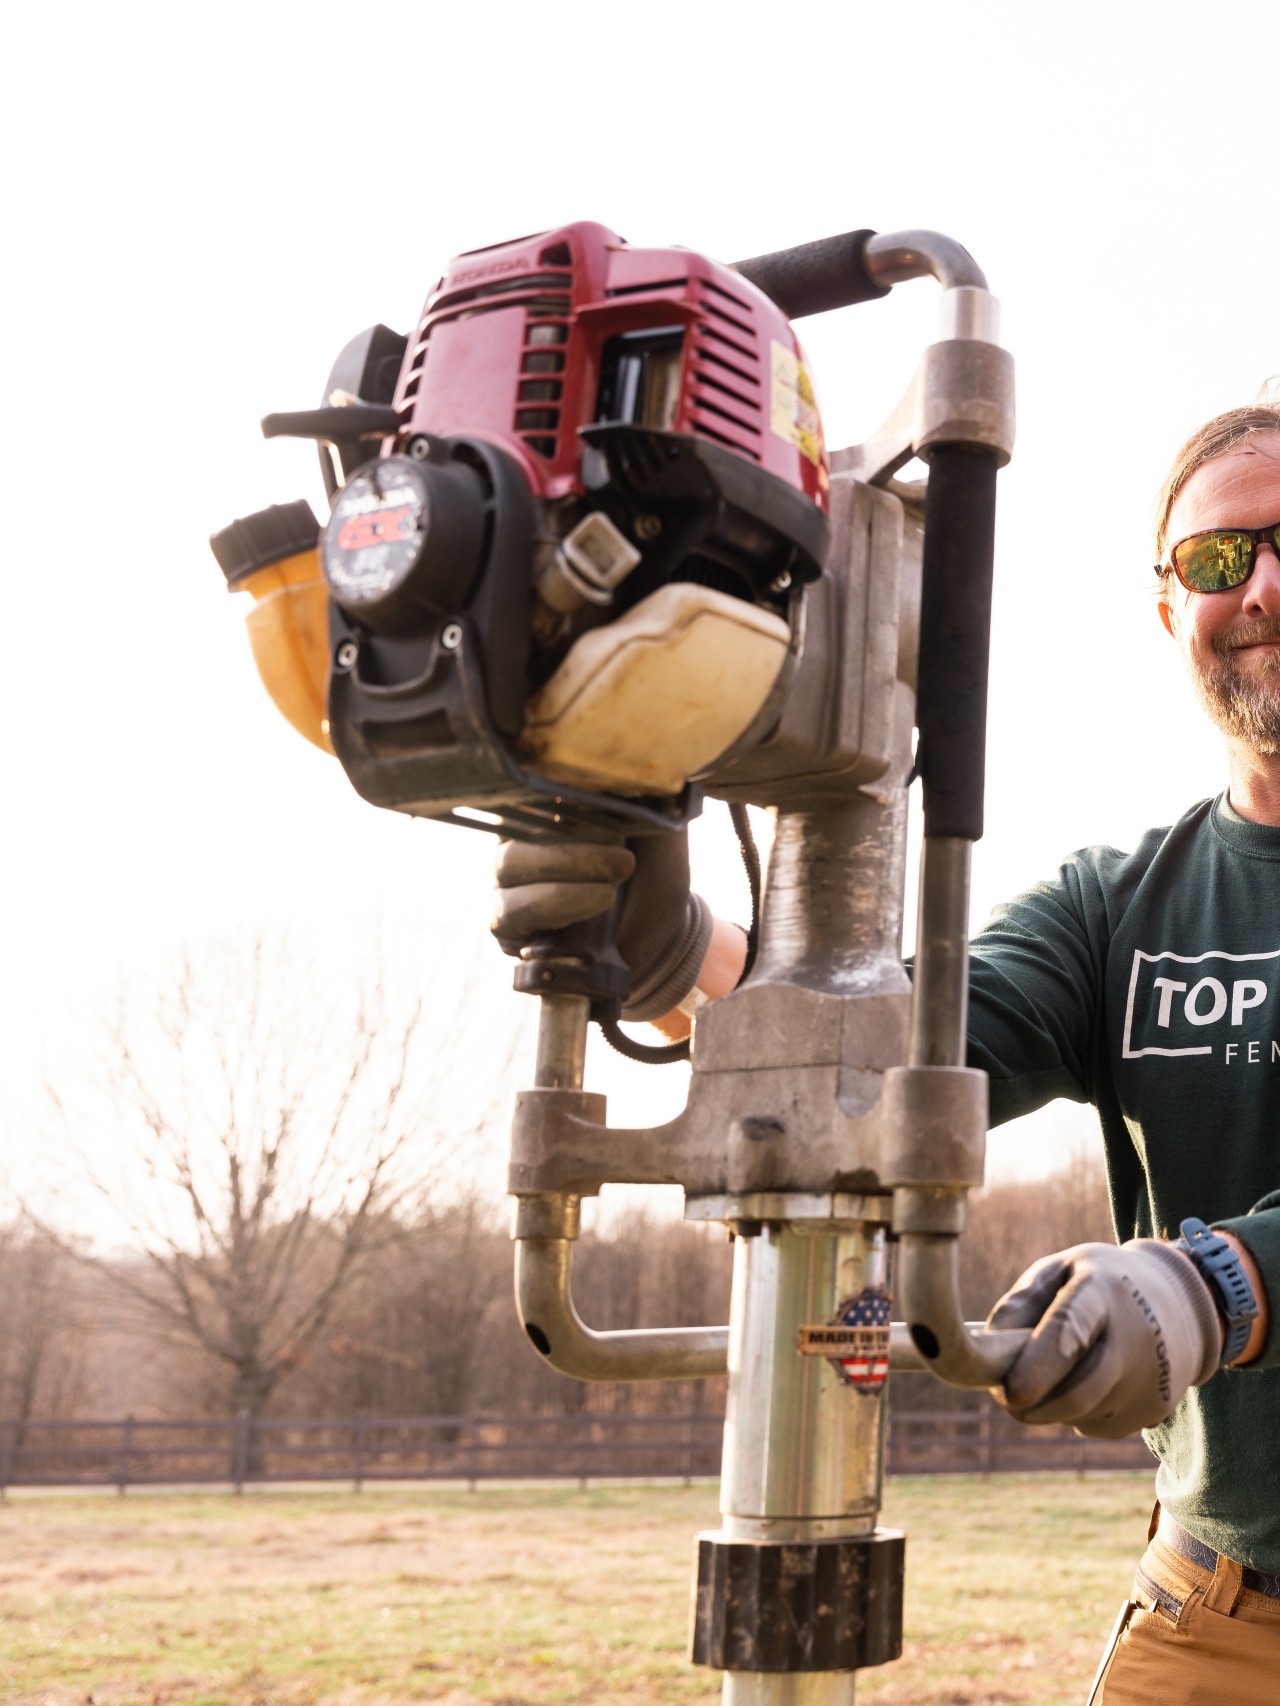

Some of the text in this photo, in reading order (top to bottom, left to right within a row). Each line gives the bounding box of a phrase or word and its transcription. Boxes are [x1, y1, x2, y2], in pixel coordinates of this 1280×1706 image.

[1153, 976, 1268, 1028] TOP
[808, 1330, 856, 1344] MADE
[1156, 1341, 1171, 1402] GRIP
